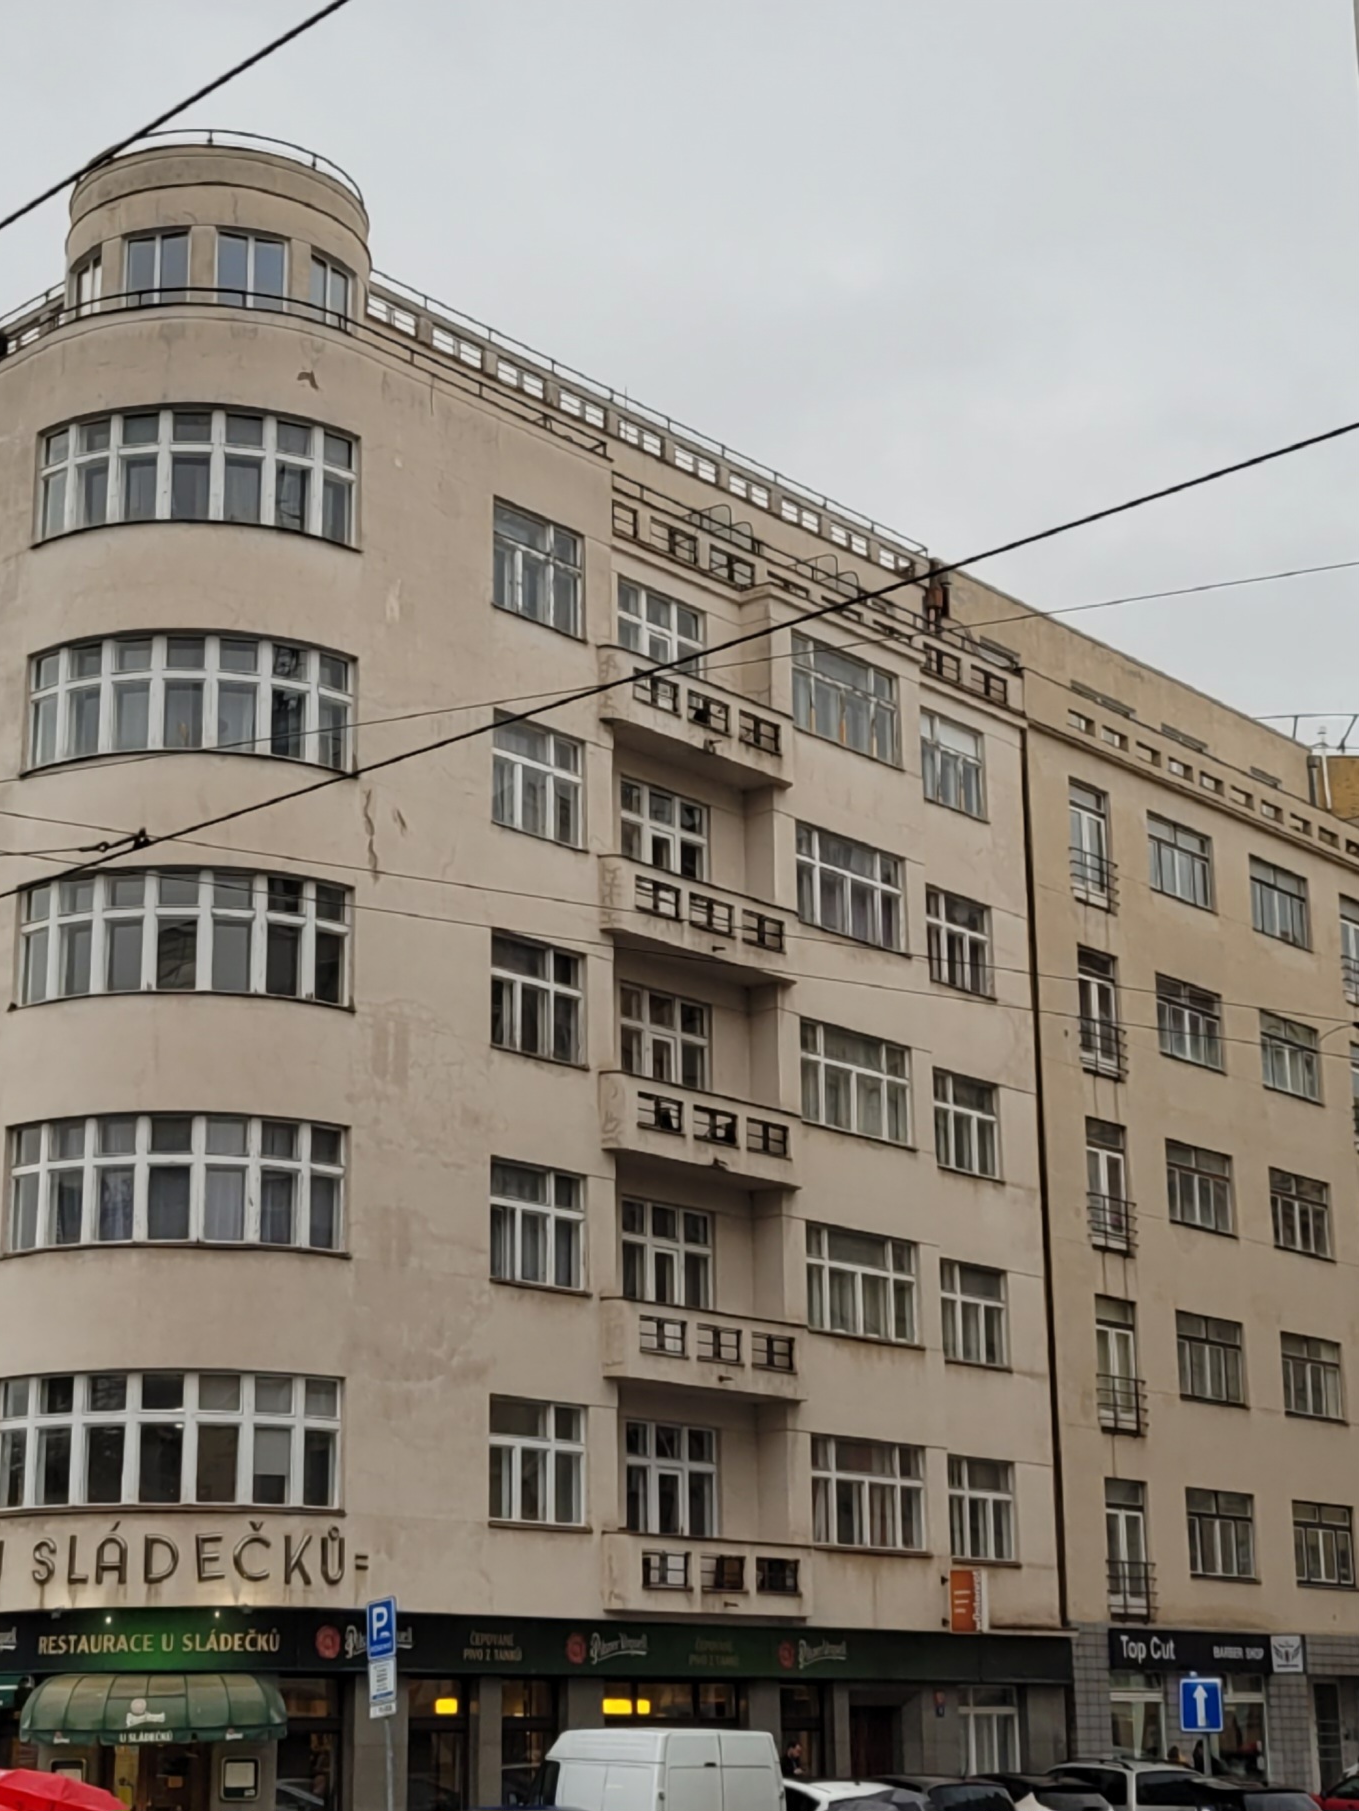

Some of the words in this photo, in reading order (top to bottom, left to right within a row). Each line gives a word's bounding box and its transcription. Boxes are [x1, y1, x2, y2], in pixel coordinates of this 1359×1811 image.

[31, 1521, 346, 1586] SLÁDEČKŮ
[372, 1606, 388, 1641] P
[38, 1633, 155, 1655] RESTAURACE
[161, 1633, 174, 1652] U
[182, 1628, 281, 1652] SLÁDEČKŮ
[1120, 1634, 1146, 1664] Top
[1150, 1635, 1176, 1660] Cut
[1245, 1646, 1265, 1660] SHOP
